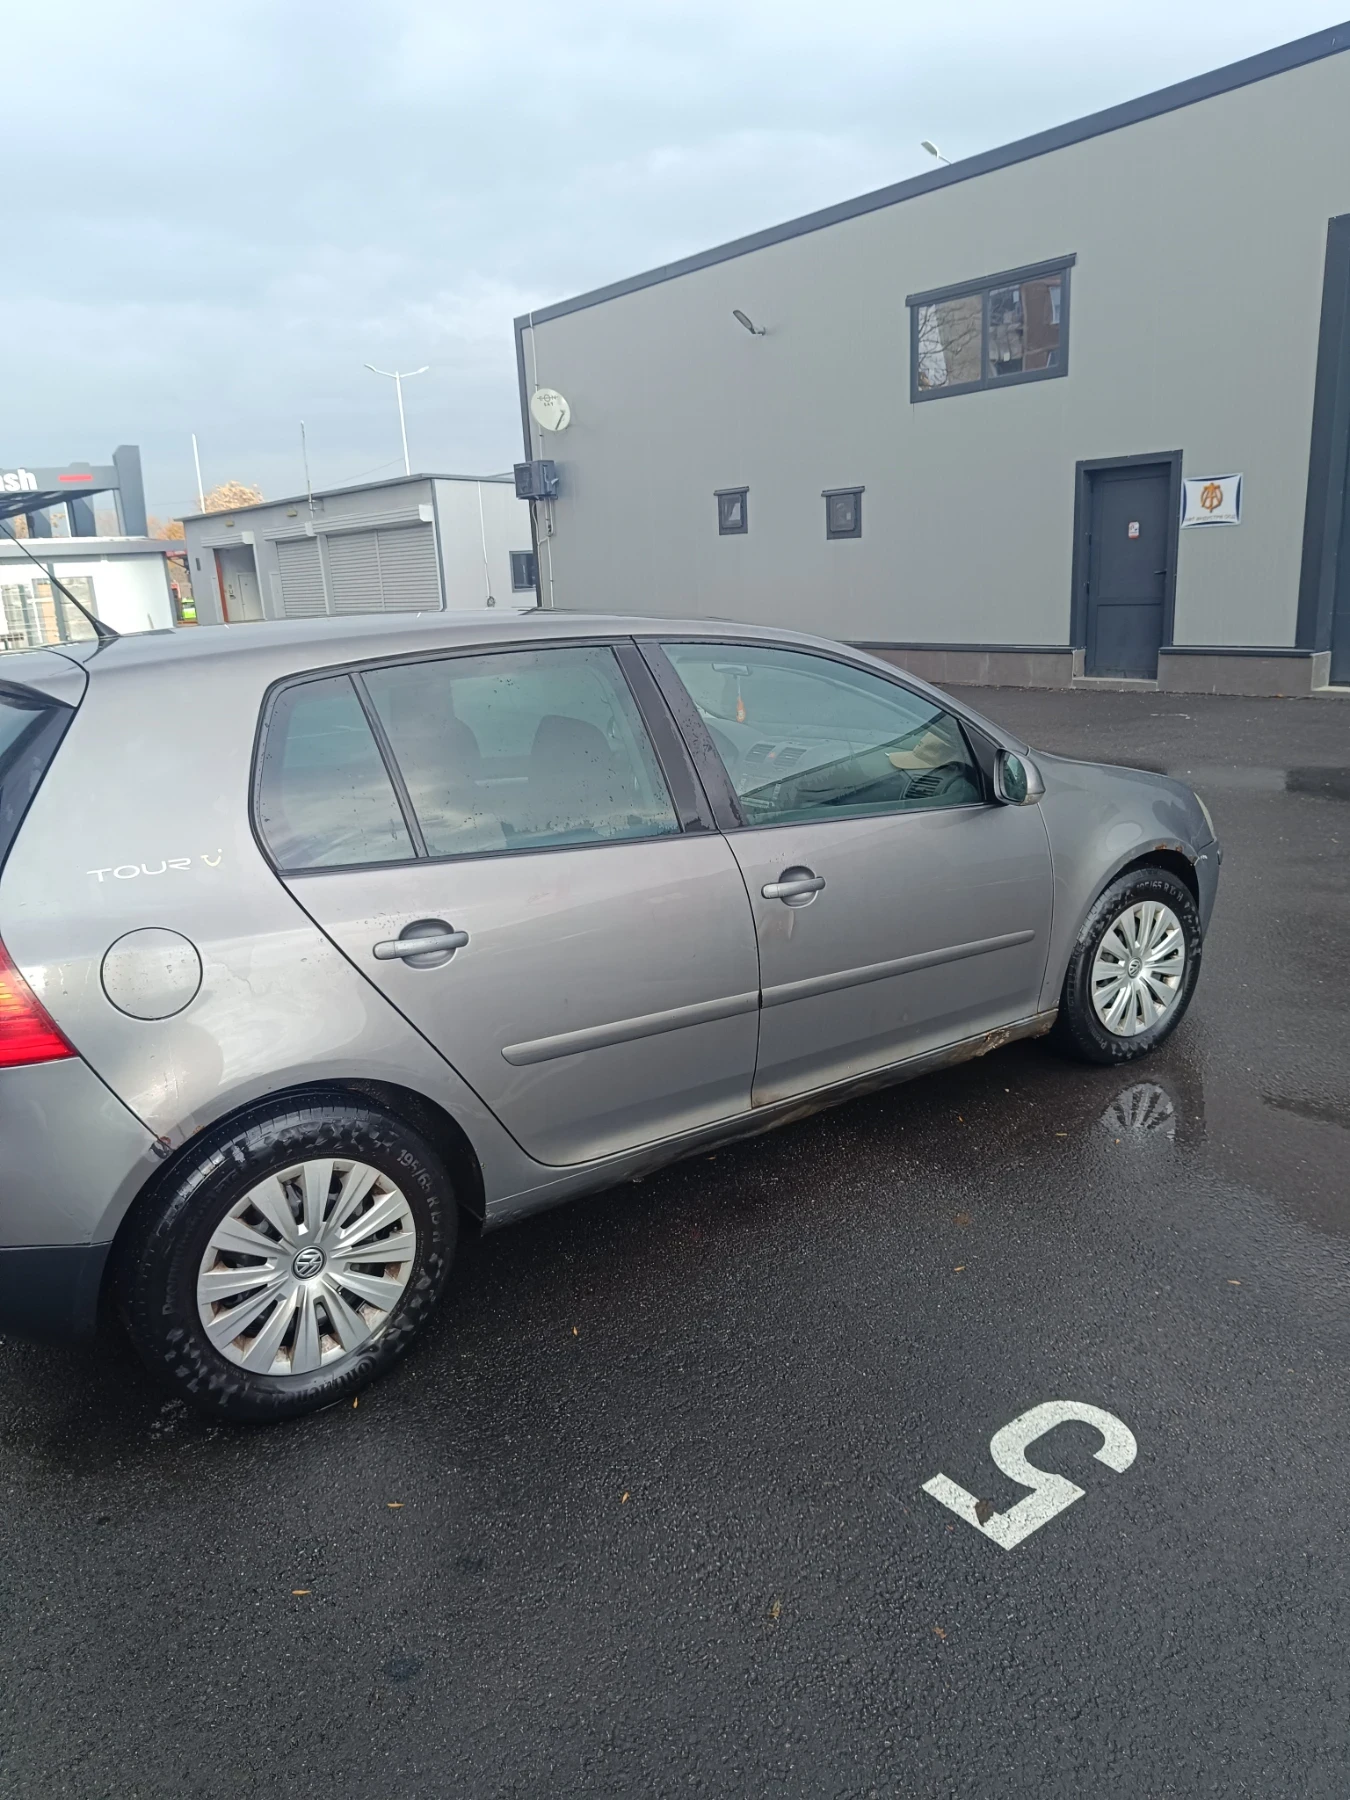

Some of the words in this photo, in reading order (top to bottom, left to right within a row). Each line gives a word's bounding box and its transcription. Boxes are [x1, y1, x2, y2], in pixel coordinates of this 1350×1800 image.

[0, 469, 38, 492] sh
[86, 857, 192, 883] TOUR
[396, 1149, 433, 1194] 195/65
[921, 1400, 1138, 1551] 5
